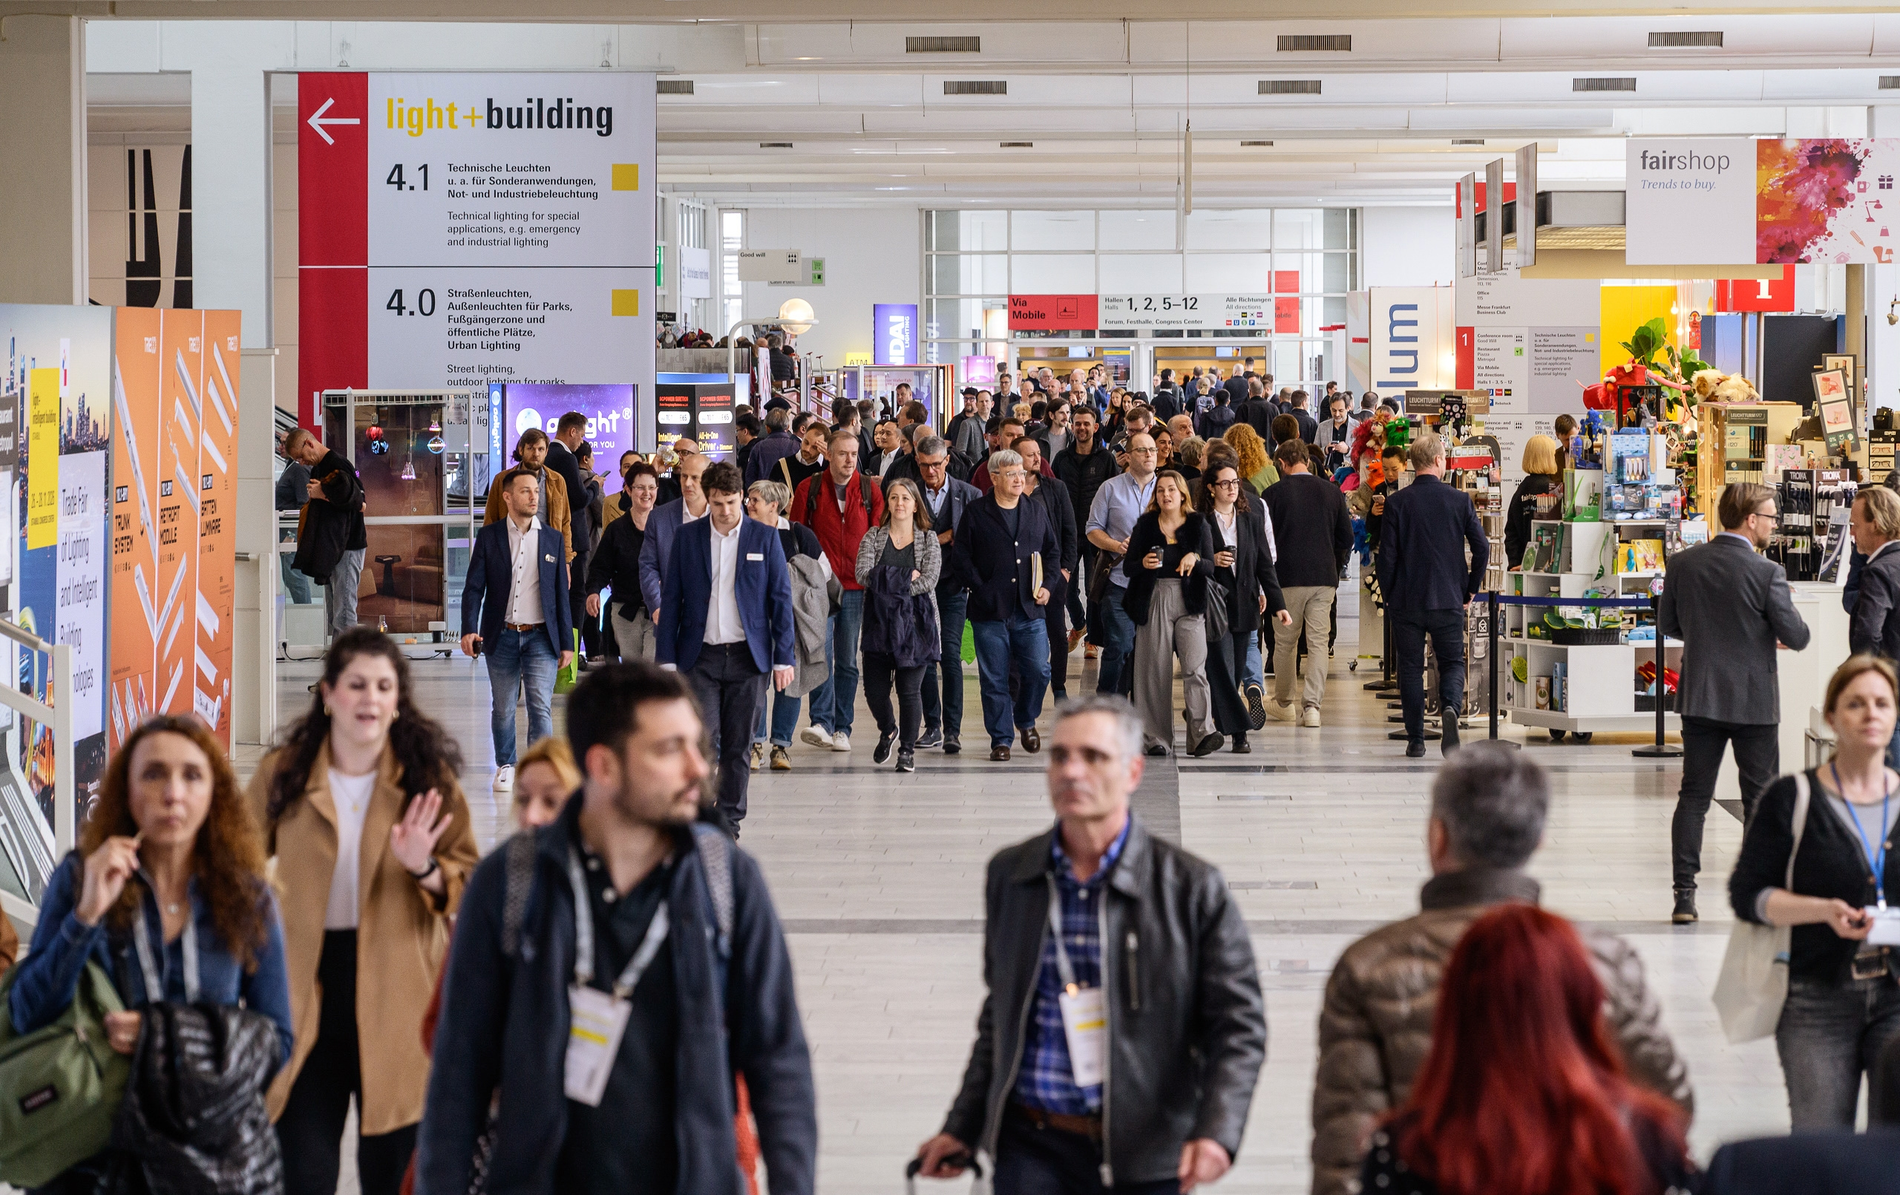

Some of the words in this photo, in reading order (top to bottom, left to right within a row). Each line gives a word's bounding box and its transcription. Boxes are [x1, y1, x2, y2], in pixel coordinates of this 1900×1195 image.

[448, 163, 502, 172] Technische
[505, 163, 551, 172] Leuchten
[1641, 149, 1730, 175] fairshop
[386, 164, 429, 190] 4.1
[472, 176, 486, 185] für
[489, 176, 596, 188] Sonderanwendungen,
[1640, 178, 1678, 190] Trends
[1680, 179, 1692, 190] to
[1694, 178, 1717, 192] buy.
[448, 190, 469, 198] Not-
[472, 190, 490, 198] und
[493, 189, 599, 201] Industriebeleuchtung
[448, 211, 491, 220] Technical
[494, 211, 529, 222] lighting
[531, 211, 545, 220] for
[548, 211, 580, 222] special
[448, 224, 506, 236] applications,
[509, 226, 526, 236] e.g.
[529, 226, 581, 235] emergency
[448, 237, 464, 246] and
[467, 237, 511, 246] industrial
[513, 237, 549, 248] lighting
[448, 288, 532, 299] Straßenleuchten,
[386, 288, 436, 316] 4.0
[1012, 298, 1028, 307] Via
[1127, 297, 1138, 312] 1,
[1143, 297, 1157, 312] 2,
[1239, 296, 1272, 304] Richtungen
[448, 301, 522, 311] Außenleuchten
[526, 301, 539, 311] für
[543, 301, 573, 312] Parks,
[448, 314, 523, 325] Fußgängerzone
[526, 314, 545, 324] und
[1012, 311, 1046, 320] Mobile
[448, 327, 500, 336] öffentliche
[503, 327, 536, 338] Plätze,
[448, 340, 477, 350] Urban
[480, 340, 521, 352] Lighting
[1462, 333, 1468, 347] 1
[447, 364, 475, 374] Street
[477, 363, 516, 376] lighting,
[447, 377, 484, 386] outdoor
[486, 377, 523, 385] lighting
[524, 377, 537, 385] for
[699, 441, 717, 452] Driver
[62, 488, 77, 517] Trade
[79, 486, 88, 514] Fair
[61, 533, 68, 562] of
[68, 530, 90, 567] Lighting
[114, 535, 134, 555] SYSTEM
[60, 578, 71, 608] and
[72, 574, 98, 608] Intelligent
